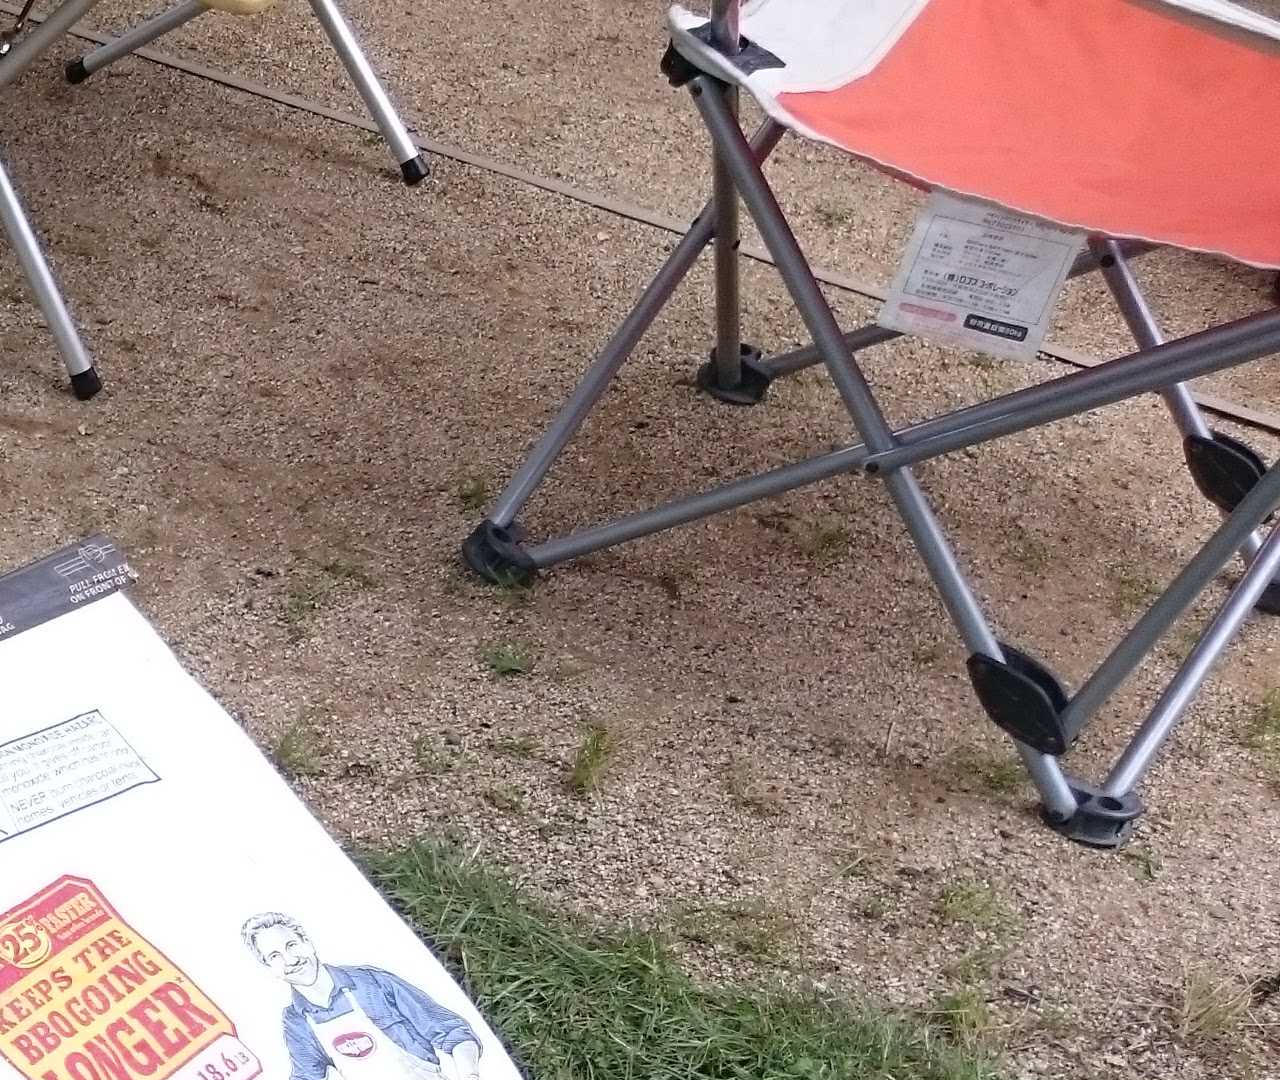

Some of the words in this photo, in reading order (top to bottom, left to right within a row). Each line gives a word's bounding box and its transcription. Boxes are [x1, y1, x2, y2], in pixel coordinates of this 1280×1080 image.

[39, 891, 99, 935] FASTER
[72, 929, 133, 975] THE
[64, 950, 163, 1028] GOING
